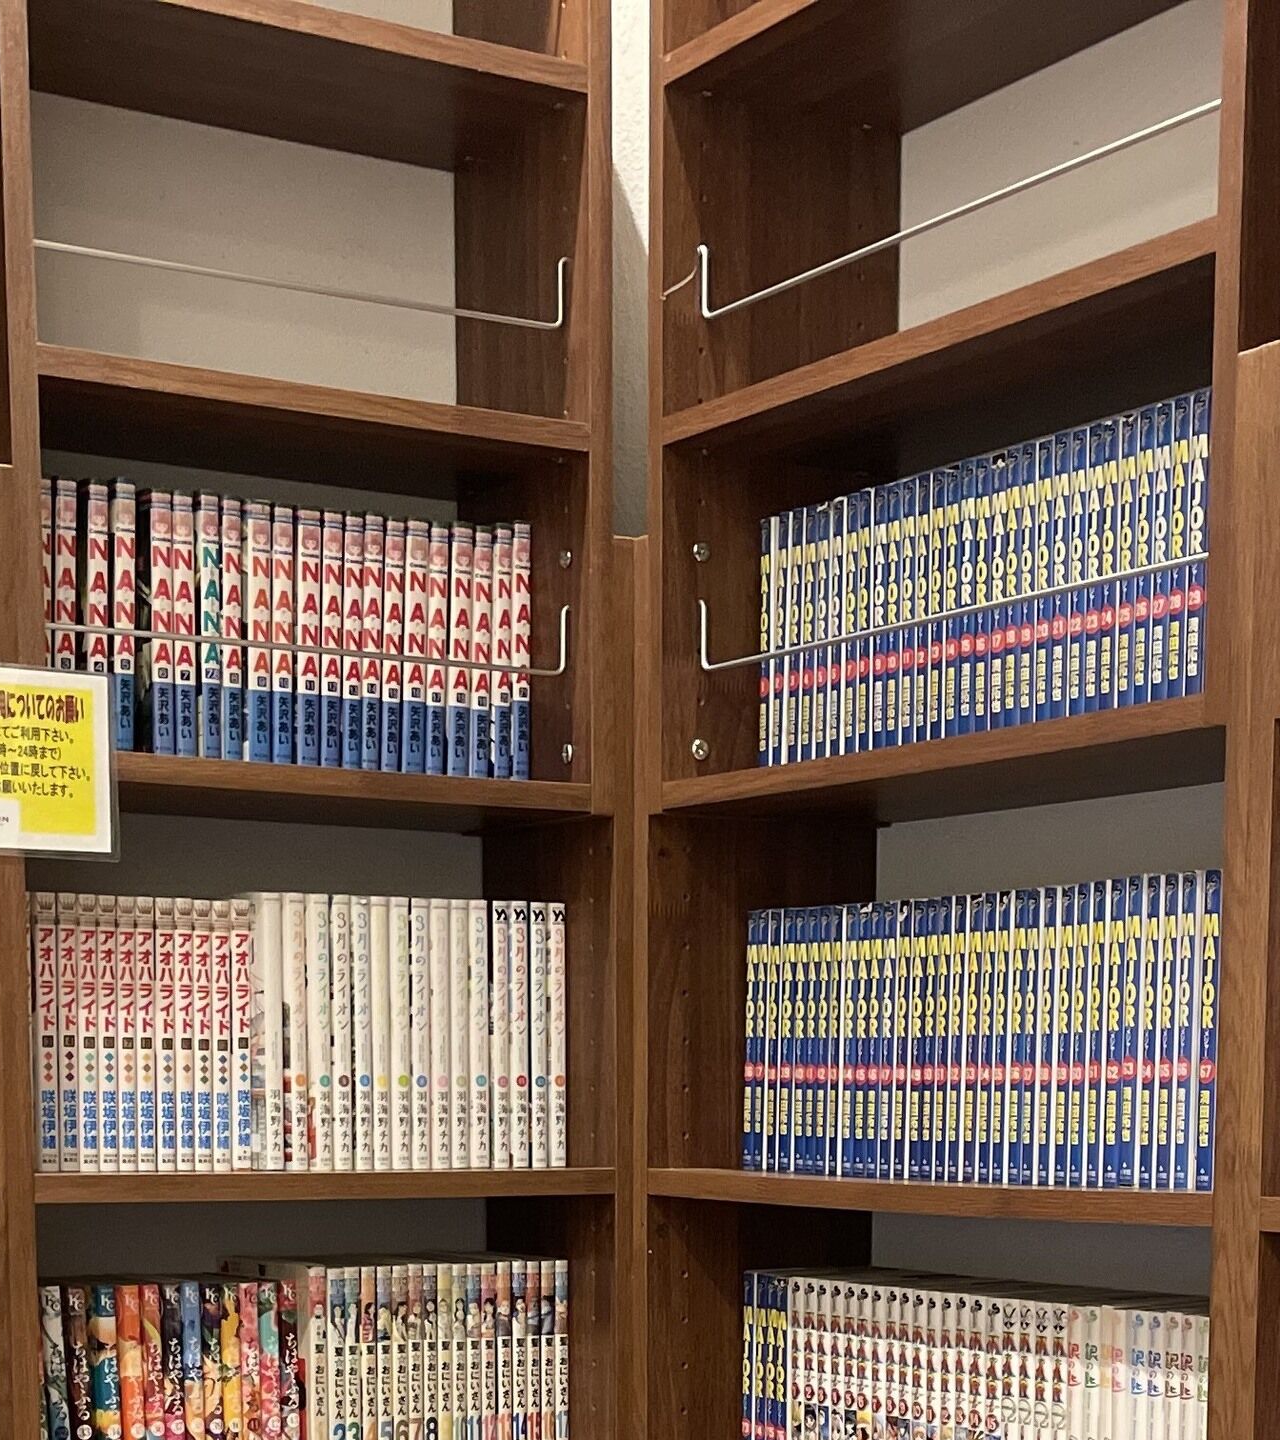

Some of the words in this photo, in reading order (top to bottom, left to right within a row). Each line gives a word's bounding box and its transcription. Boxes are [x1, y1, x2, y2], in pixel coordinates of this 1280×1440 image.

[1154, 446, 1171, 563] MAJOR
[1171, 441, 1189, 558] MAJOR
[152, 547, 171, 665] NANA
[174, 549, 193, 667] NANA
[253, 556, 269, 674] NANA
[993, 634, 1000, 645] 17
[1154, 599, 1164, 612] 27
[158, 687, 169, 737] 矢沢あい
[180, 689, 192, 739] 矢沢あい
[181, 670, 190, 680] 7
[257, 696, 267, 744] 矢沢あい
[39, 928, 55, 1031] アオハライド
[61, 928, 76, 1031] アオハライド
[120, 931, 135, 1033] アオハライド
[336, 911, 350, 1030] 3月のライオン
[357, 911, 370, 1030] 3月のライオン
[415, 914, 427, 1032] 3月のライオン
[1109, 920, 1125, 1031] MAJOR
[1202, 914, 1220, 1029] MAJOR
[338, 1091, 350, 1152] 羽海野チカ
[359, 1091, 370, 1152] 羽海野チカ
[418, 1091, 428, 1152] 羽海野チカ
[1200, 1065, 1212, 1078] 67
[516, 1412, 527, 1440] 14
